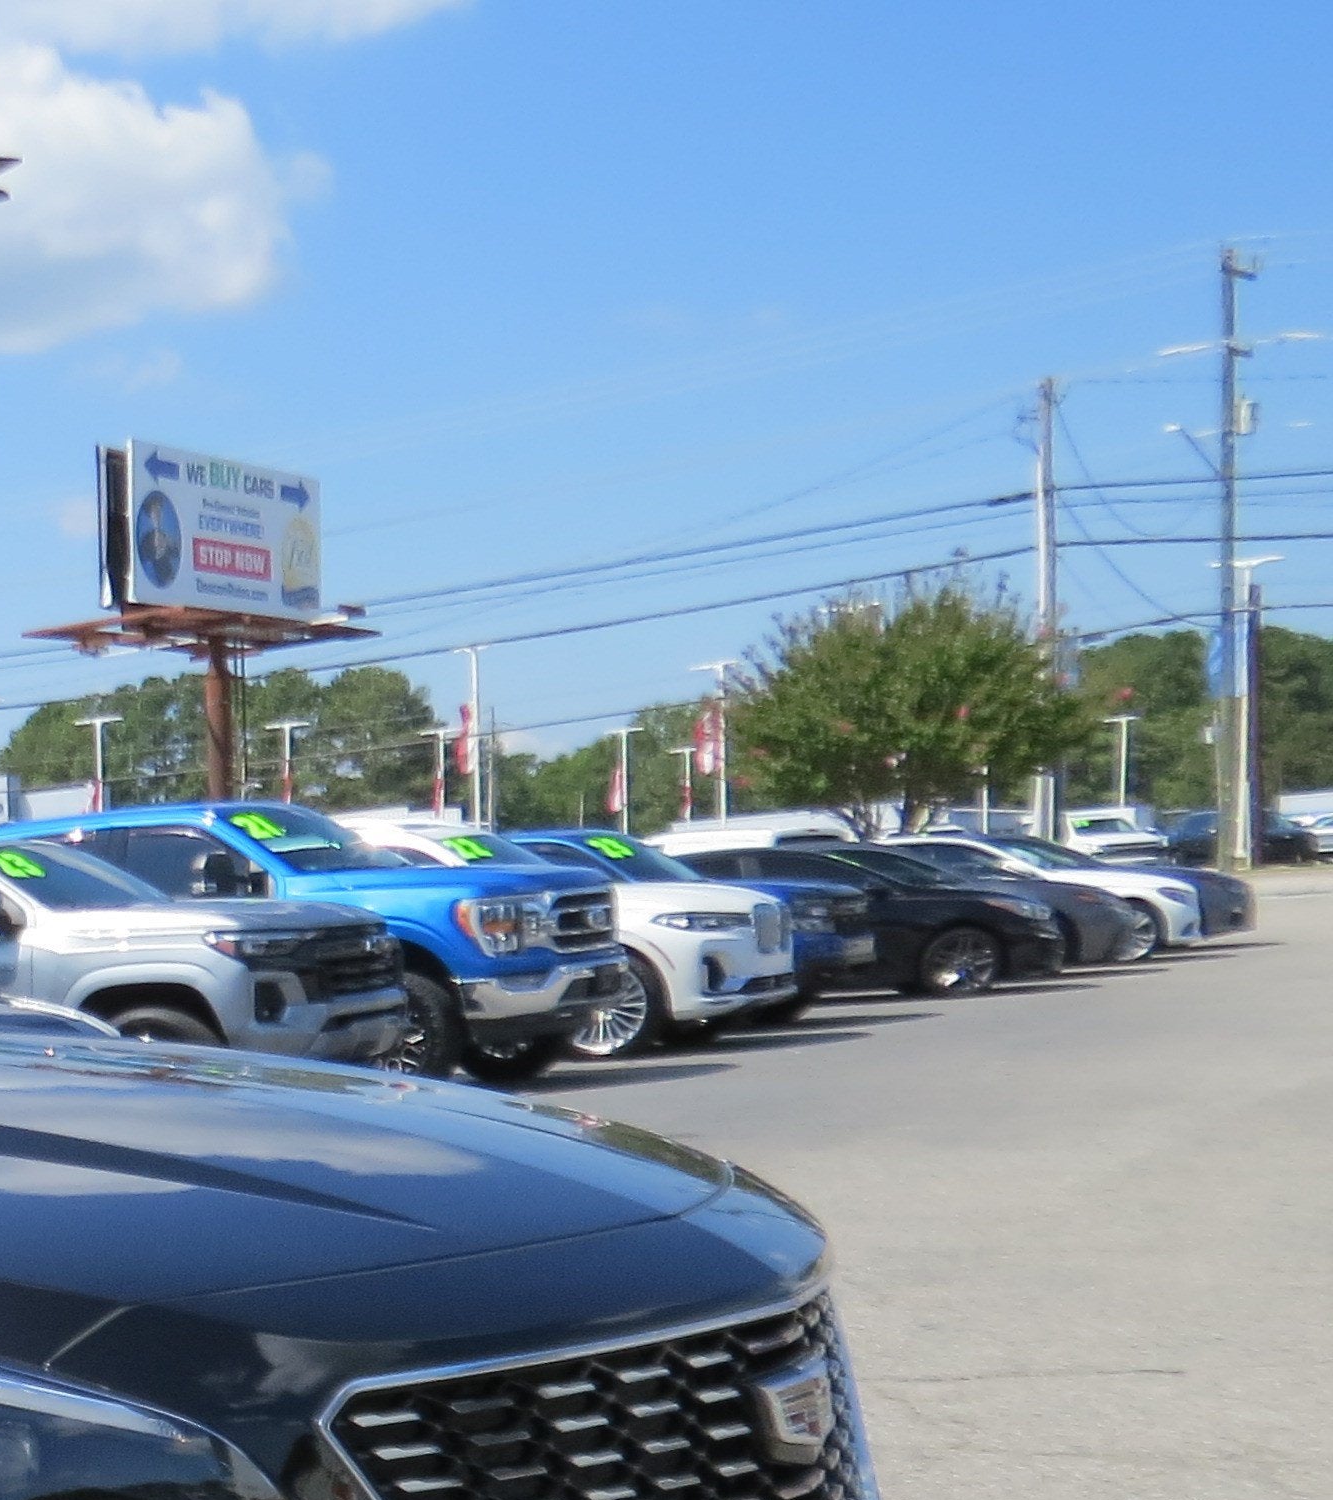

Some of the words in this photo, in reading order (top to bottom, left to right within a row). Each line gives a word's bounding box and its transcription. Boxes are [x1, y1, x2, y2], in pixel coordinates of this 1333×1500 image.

[186, 462, 207, 487] WE
[209, 461, 242, 492] BUY
[199, 545, 233, 569] STOP
[234, 550, 265, 574] NOW
